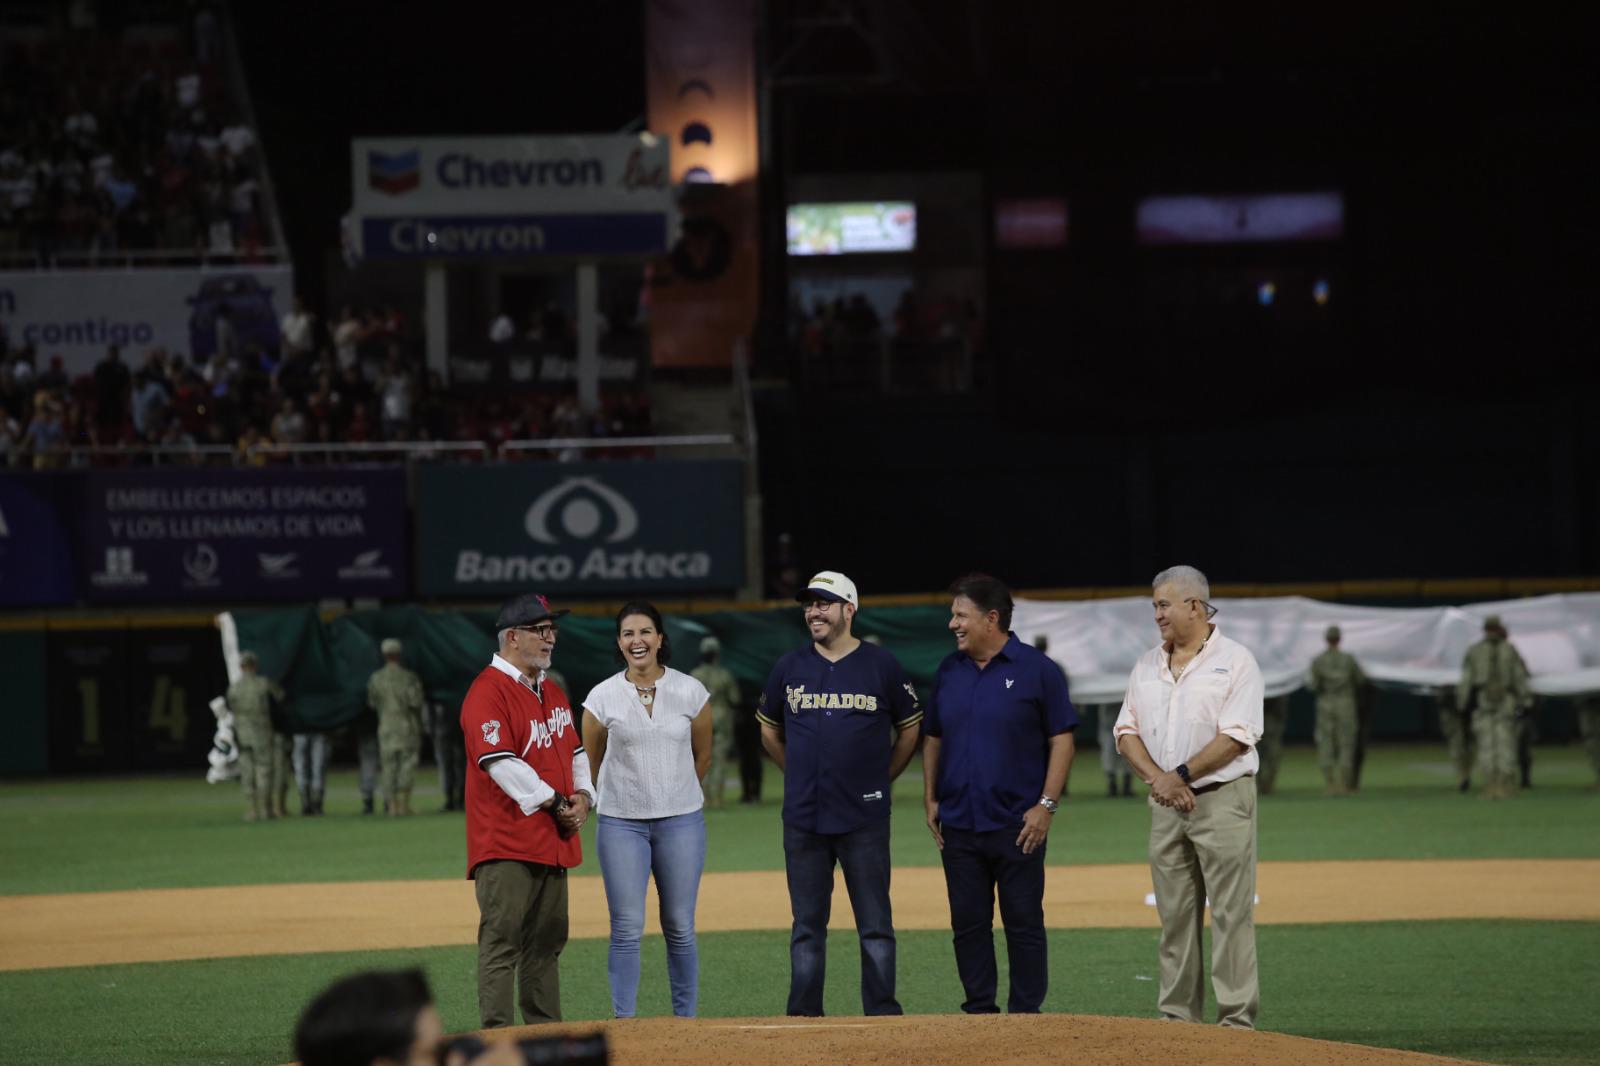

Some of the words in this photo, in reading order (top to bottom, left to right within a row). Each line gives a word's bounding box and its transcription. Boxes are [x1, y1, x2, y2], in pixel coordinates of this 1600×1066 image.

[436, 153, 604, 189] Chevron
[390, 220, 545, 252] Chevron
[23, 319, 154, 347] contigo
[105, 486, 269, 512] EMBELLECEMOS
[271, 486, 366, 510] ESPACIOS
[108, 516, 123, 539] Y
[126, 516, 166, 540] LOS
[168, 515, 281, 539] LLENAMOS
[283, 514, 313, 537] DE
[315, 513, 366, 537] VIDA
[455, 549, 574, 583] Banco
[578, 547, 712, 582] Azteca
[76, 676, 99, 743] 1
[148, 674, 188, 742] 4
[786, 684, 878, 714] VENADOS
